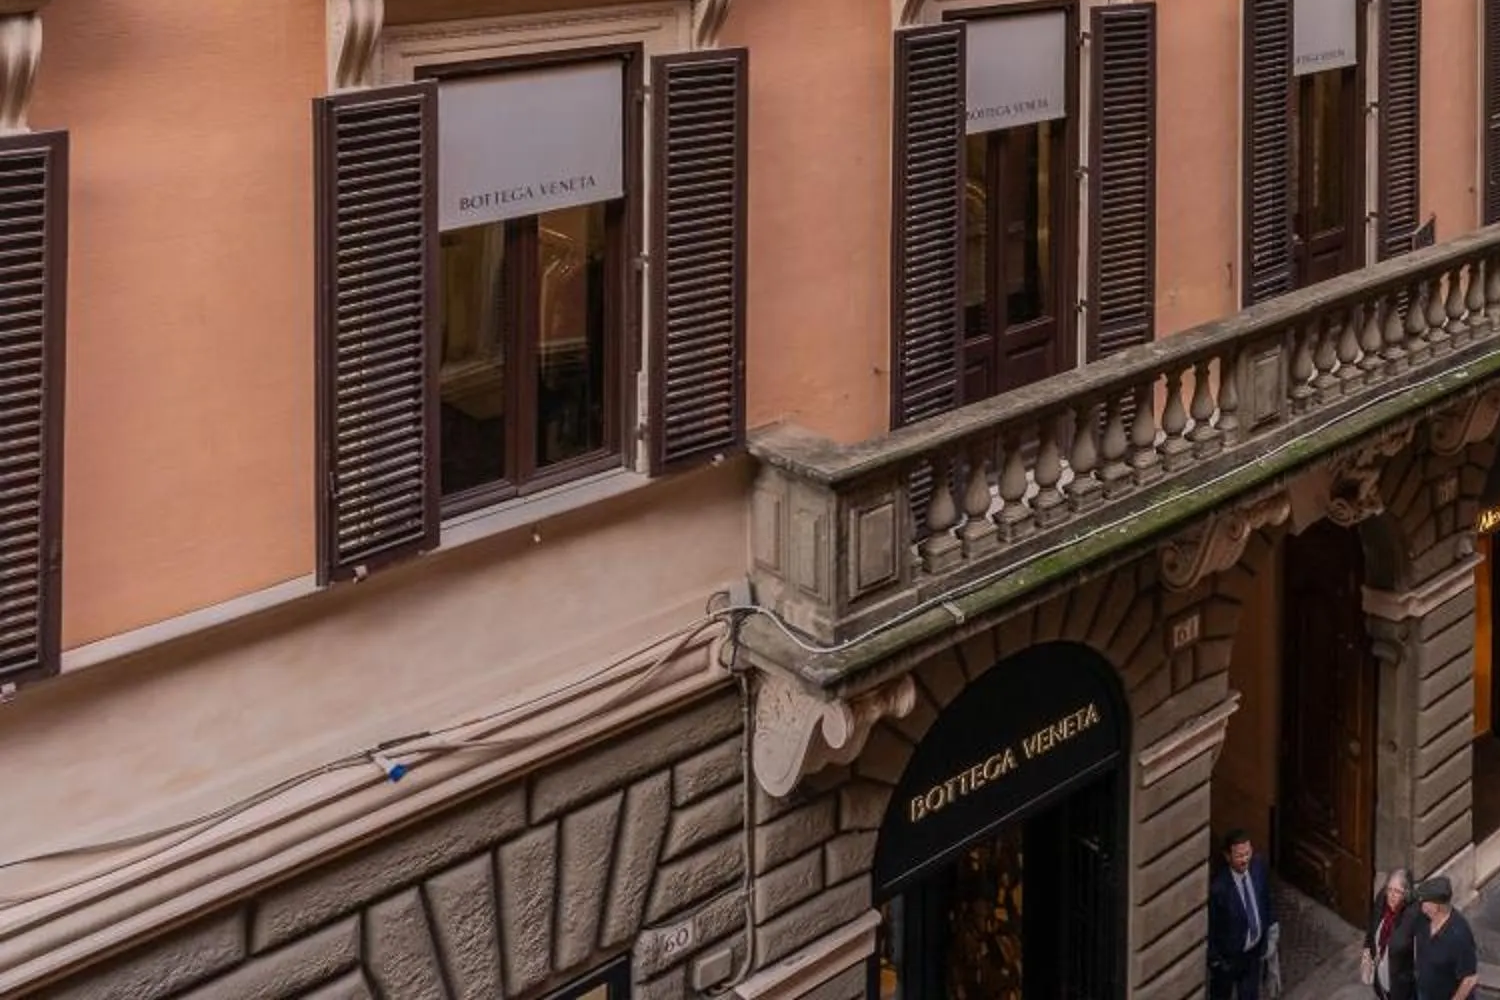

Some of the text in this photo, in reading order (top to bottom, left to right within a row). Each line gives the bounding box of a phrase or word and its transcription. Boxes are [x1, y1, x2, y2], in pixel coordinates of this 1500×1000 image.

[460, 174, 596, 211] BOTTEGA VENETA
[910, 702, 1101, 823] BOTTEGA VENETA
